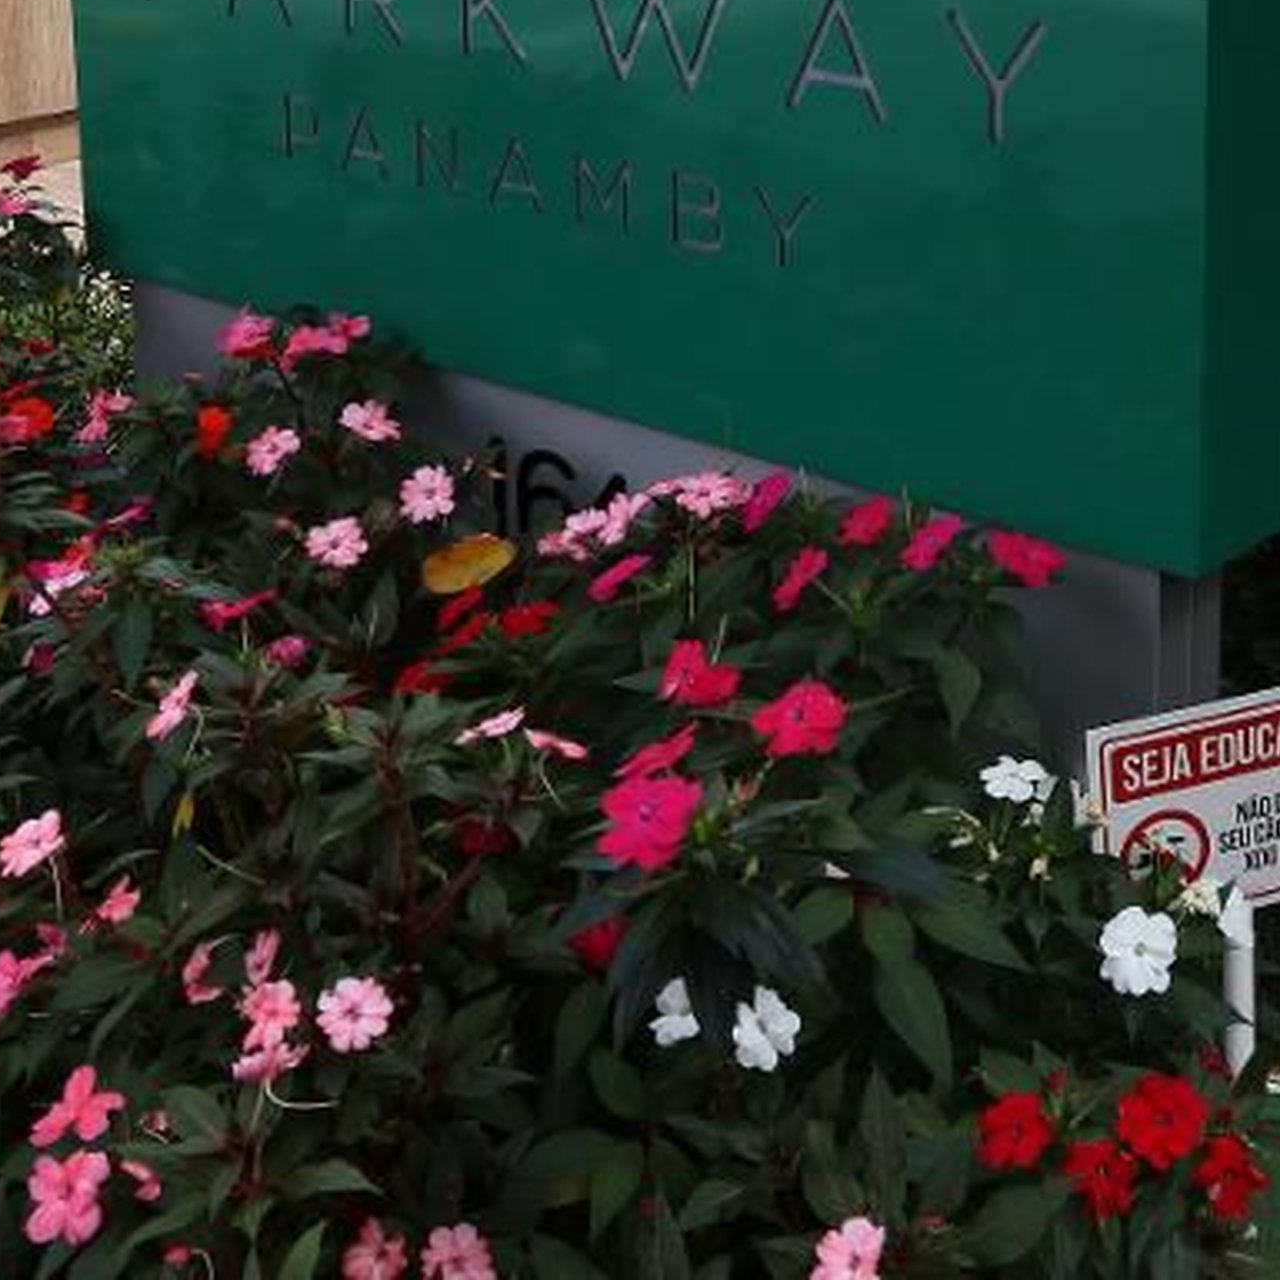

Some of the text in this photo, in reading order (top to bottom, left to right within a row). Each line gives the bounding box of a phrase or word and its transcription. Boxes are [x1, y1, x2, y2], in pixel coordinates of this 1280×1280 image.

[281, 91, 815, 269] PANAMBY
[1121, 742, 1193, 792] SEJA
[1235, 792, 1272, 824] NÃO
[1219, 824, 1251, 852] SEU
